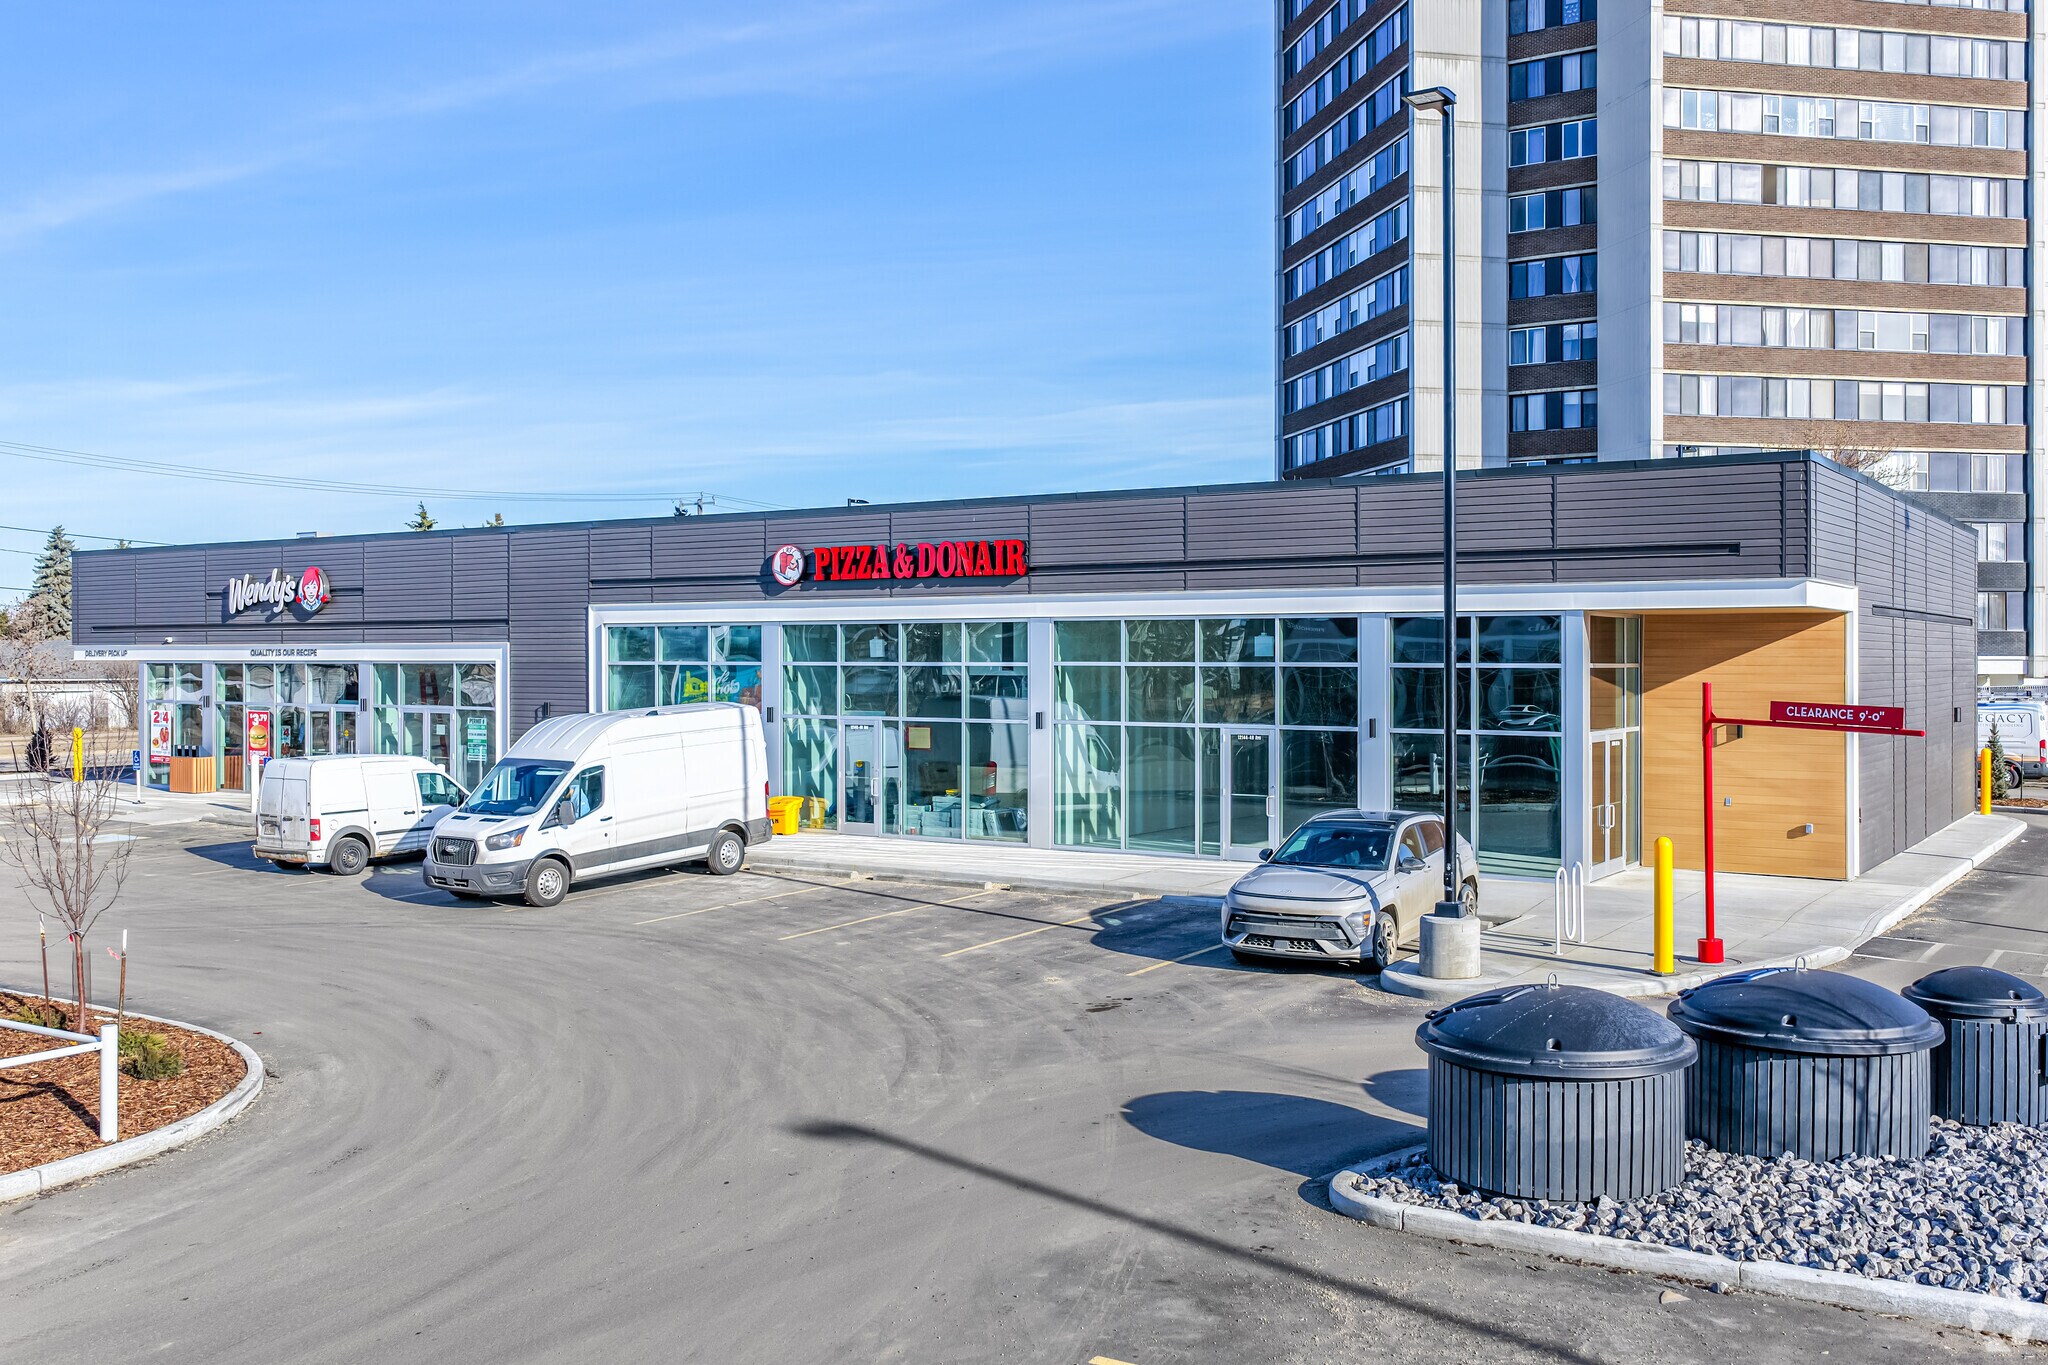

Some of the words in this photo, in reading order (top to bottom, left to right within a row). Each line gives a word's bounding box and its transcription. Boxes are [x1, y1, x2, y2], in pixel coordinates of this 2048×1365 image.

[814, 544, 891, 581] PIZZA
[893, 543, 914, 579] &
[917, 539, 1027, 577] DONAIR
[229, 568, 296, 614] Wendy's
[250, 648, 275, 657] QUALITY
[275, 648, 281, 656] IS
[283, 648, 295, 656] OUR
[296, 648, 317, 656] RECIPE
[153, 711, 160, 724] 2
[250, 713, 268, 726] $3.79
[1786, 706, 1854, 720] CLEARANCE
[1978, 713, 2026, 723] EGACY
